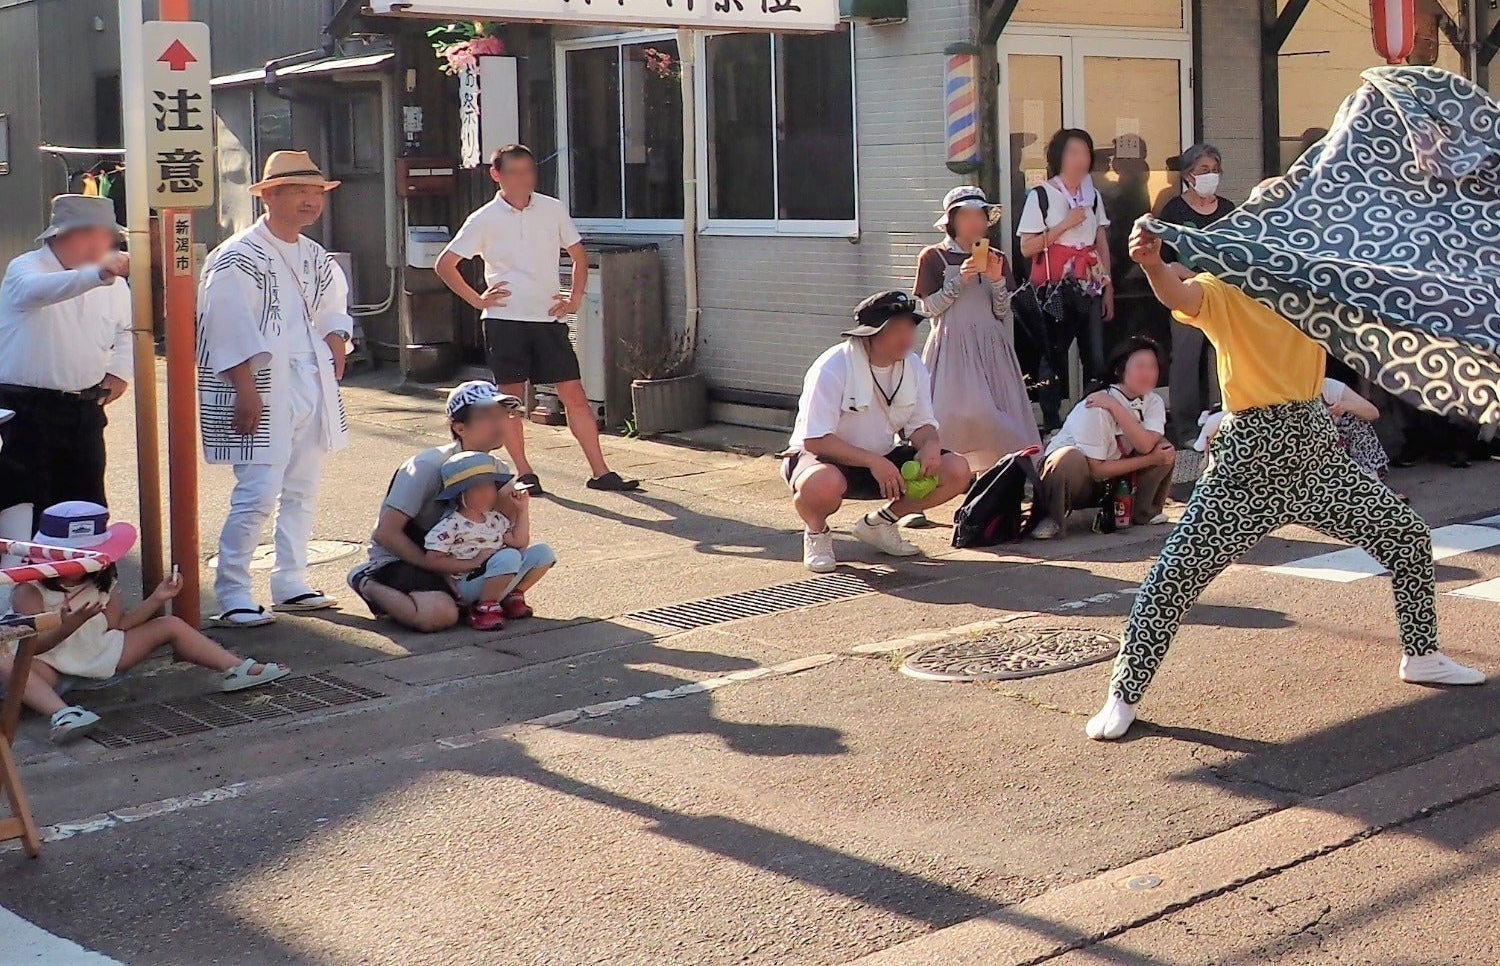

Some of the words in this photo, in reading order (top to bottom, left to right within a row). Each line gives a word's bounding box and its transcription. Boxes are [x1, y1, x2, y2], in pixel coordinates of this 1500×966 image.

[152, 89, 204, 194] 注意
[175, 220, 190, 271] 新潟市
